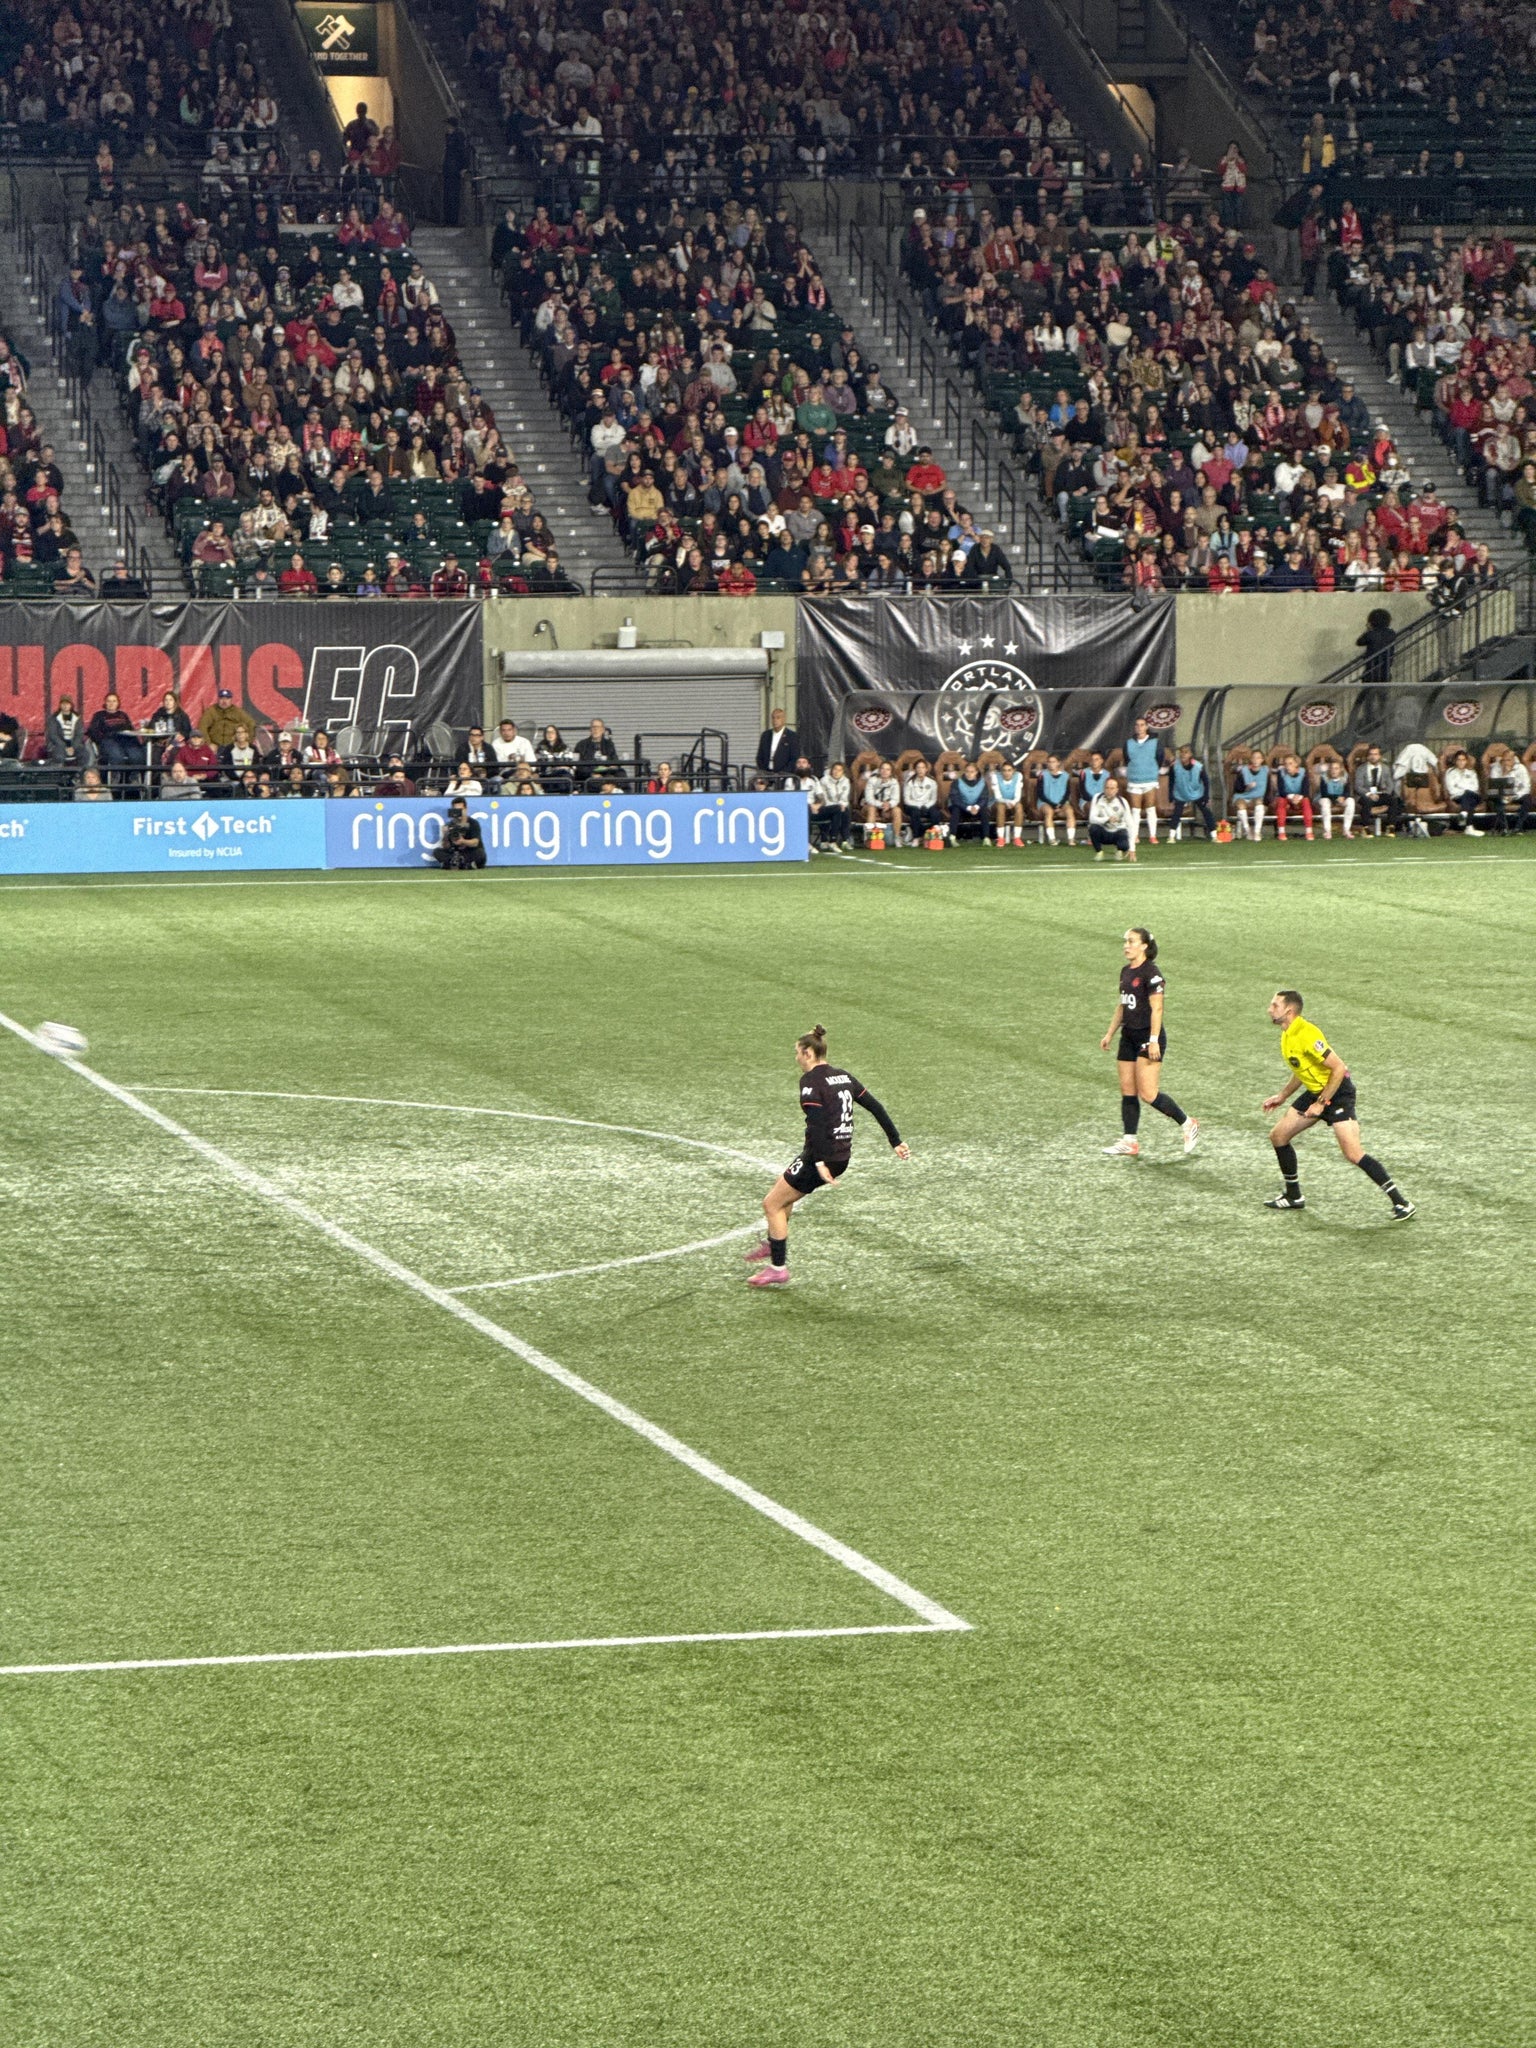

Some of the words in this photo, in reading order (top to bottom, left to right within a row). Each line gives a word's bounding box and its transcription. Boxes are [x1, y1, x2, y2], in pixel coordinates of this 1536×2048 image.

[298, 643, 419, 756] FC
[133, 816, 187, 836] First
[471, 801, 561, 860] ing
[580, 800, 672, 859] ring
[693, 797, 785, 857] ring
[168, 847, 202, 858] Insured
[203, 847, 215, 860] by
[216, 846, 243, 857] NCUA
[837, 1089, 853, 1122] 13
